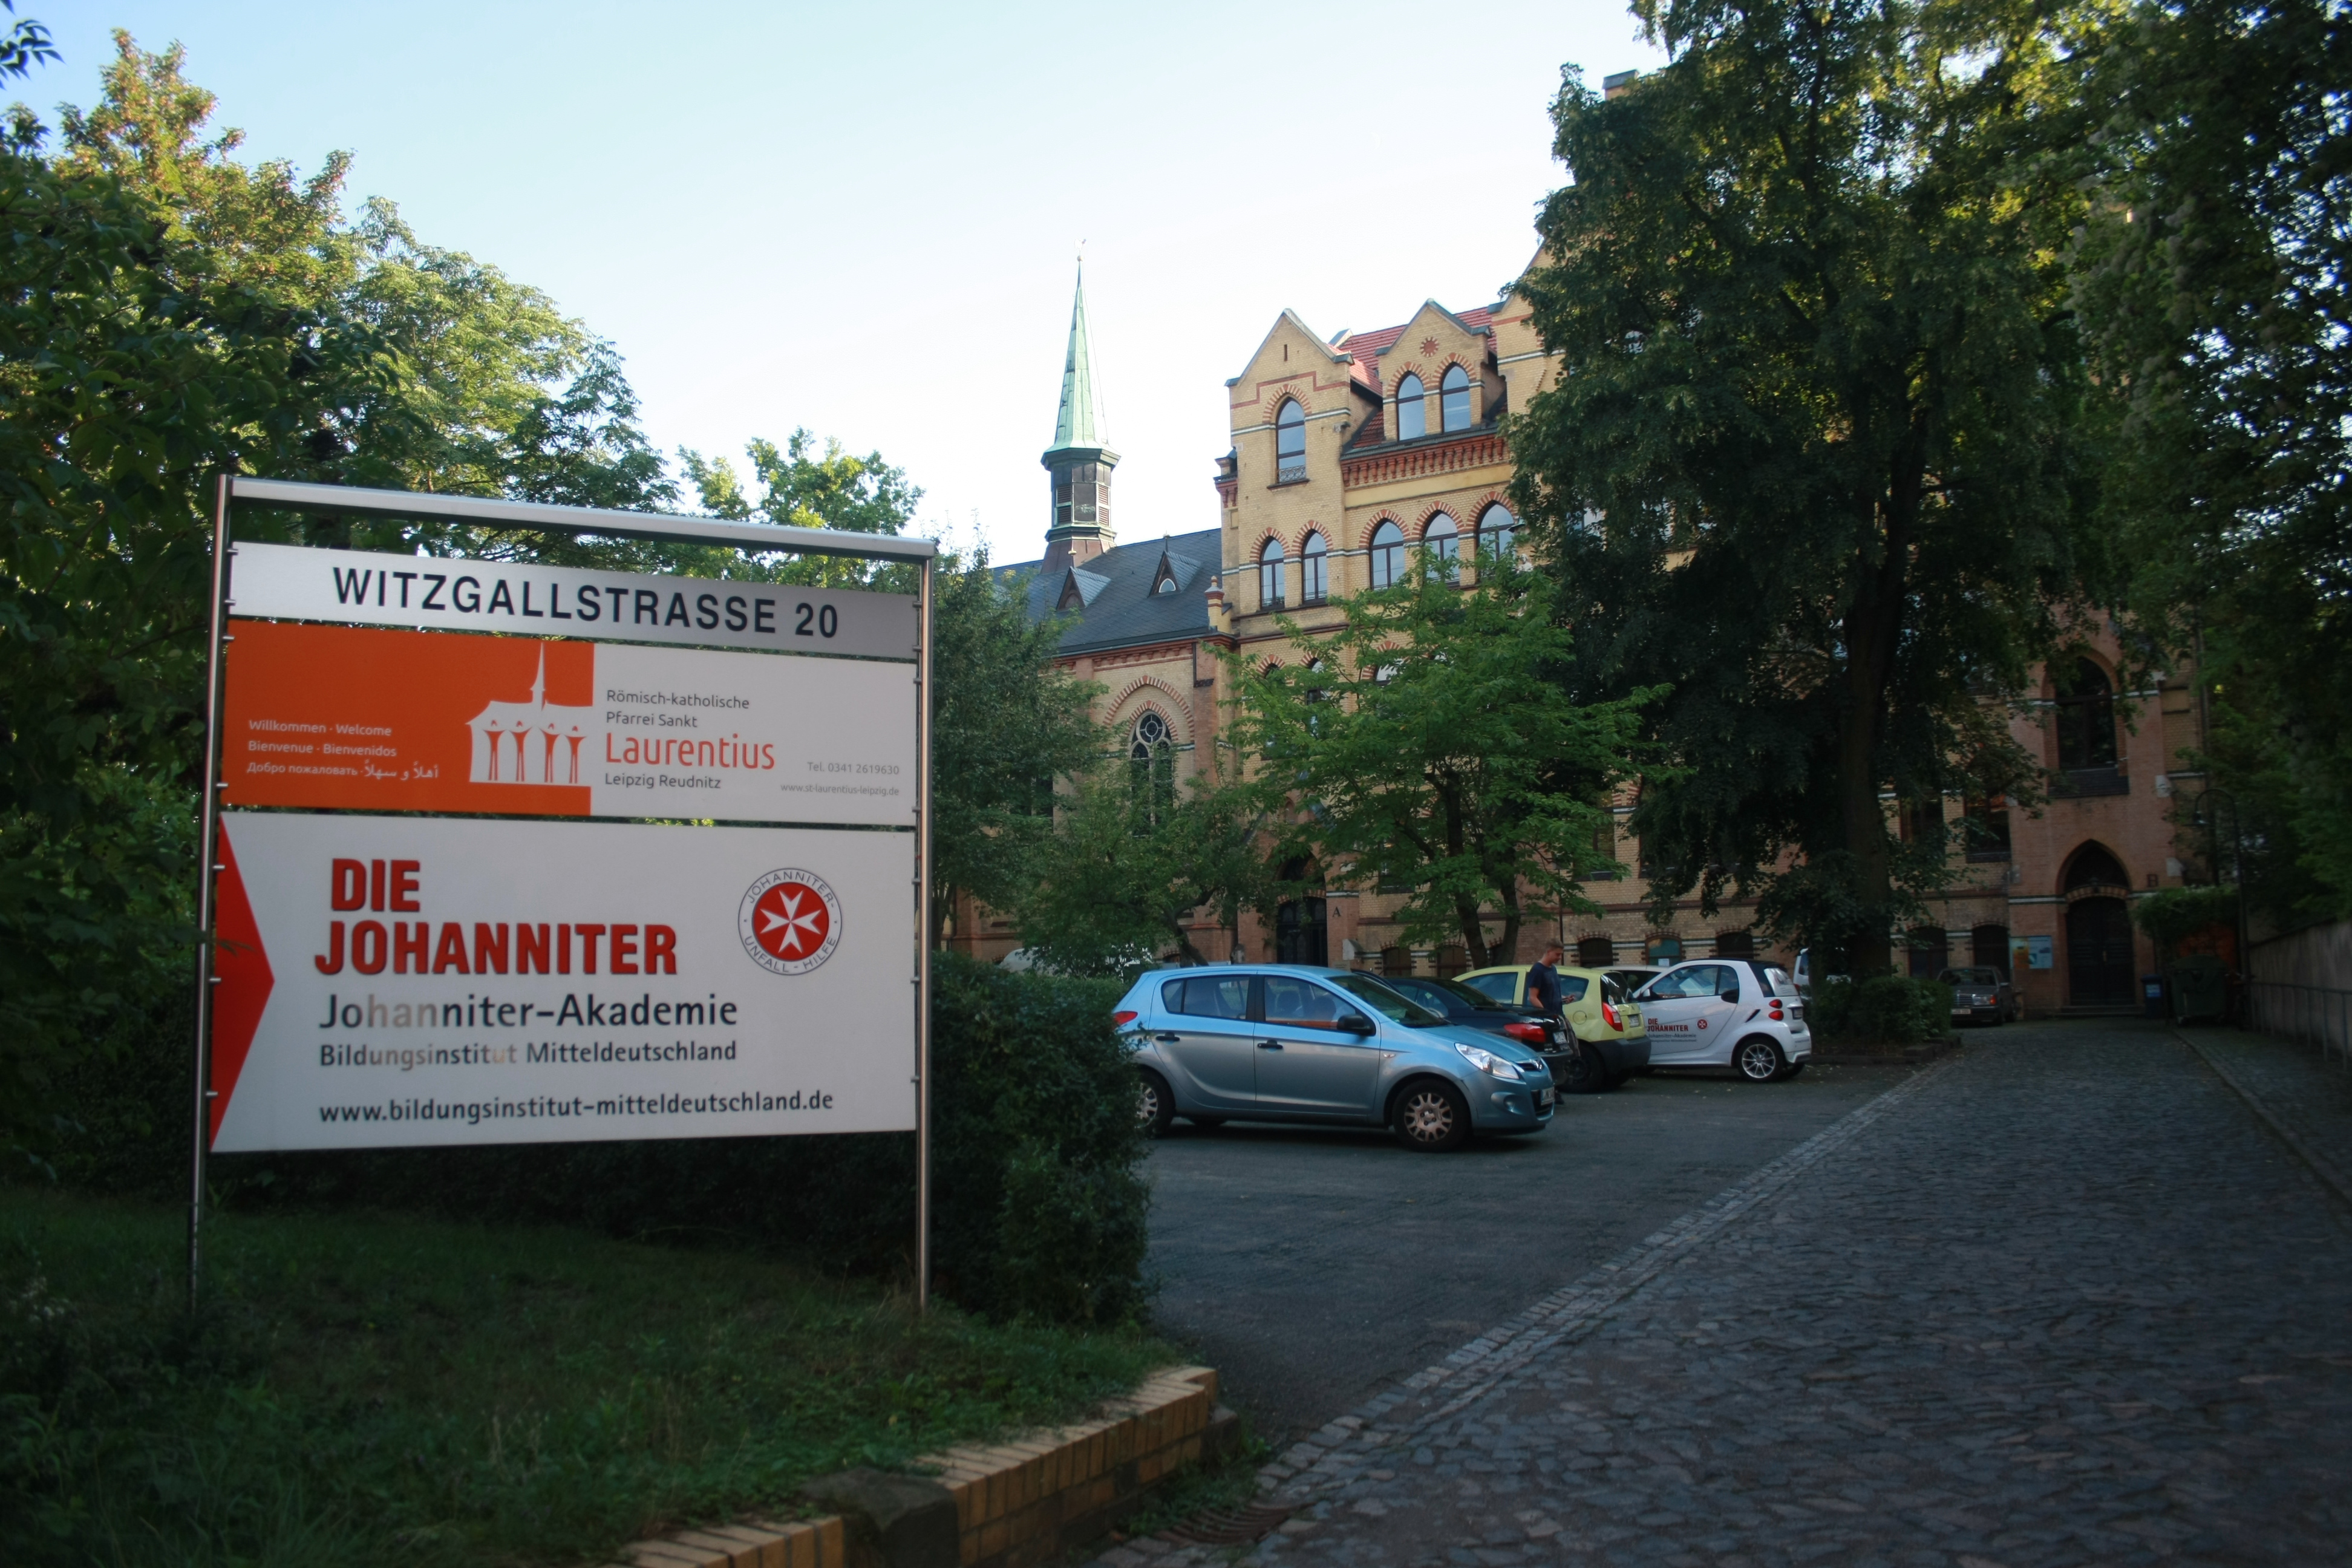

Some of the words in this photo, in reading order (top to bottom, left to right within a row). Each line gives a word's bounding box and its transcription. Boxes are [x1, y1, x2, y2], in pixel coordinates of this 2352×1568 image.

[333, 567, 776, 634] WITZGALLSTRASSE
[795, 602, 838, 638] 20
[606, 690, 750, 709] Römisch-katholische
[249, 719, 327, 733] Willkommen
[336, 724, 392, 736] Welcome
[606, 711, 655, 725] Pfarrei
[658, 714, 698, 728] Sankt
[248, 740, 314, 753] Bienvenue
[323, 743, 397, 757] Bienvenidos
[606, 732, 775, 770] Laurentius
[247, 762, 286, 775] Добро
[289, 766, 358, 776] пожаловать
[807, 762, 825, 772] Tel.
[828, 762, 852, 773] 0341
[856, 763, 900, 775] 2619630
[605, 773, 655, 789] Leipzig
[659, 774, 721, 789] Reudnitz
[780, 783, 900, 797] www.st-laurentius-leipzig.de
[330, 858, 420, 912] DIE
[1332, 906, 1341, 917] A
[314, 920, 678, 975] JOHANNITER
[319, 993, 738, 1029] Johanniter-Akademie
[320, 1042, 518, 1071] Bildungsinstitut
[526, 1040, 737, 1064] Mitteldeutschland
[319, 1090, 834, 1125] www.bildungsinstitut-mitteldeutschland.de
